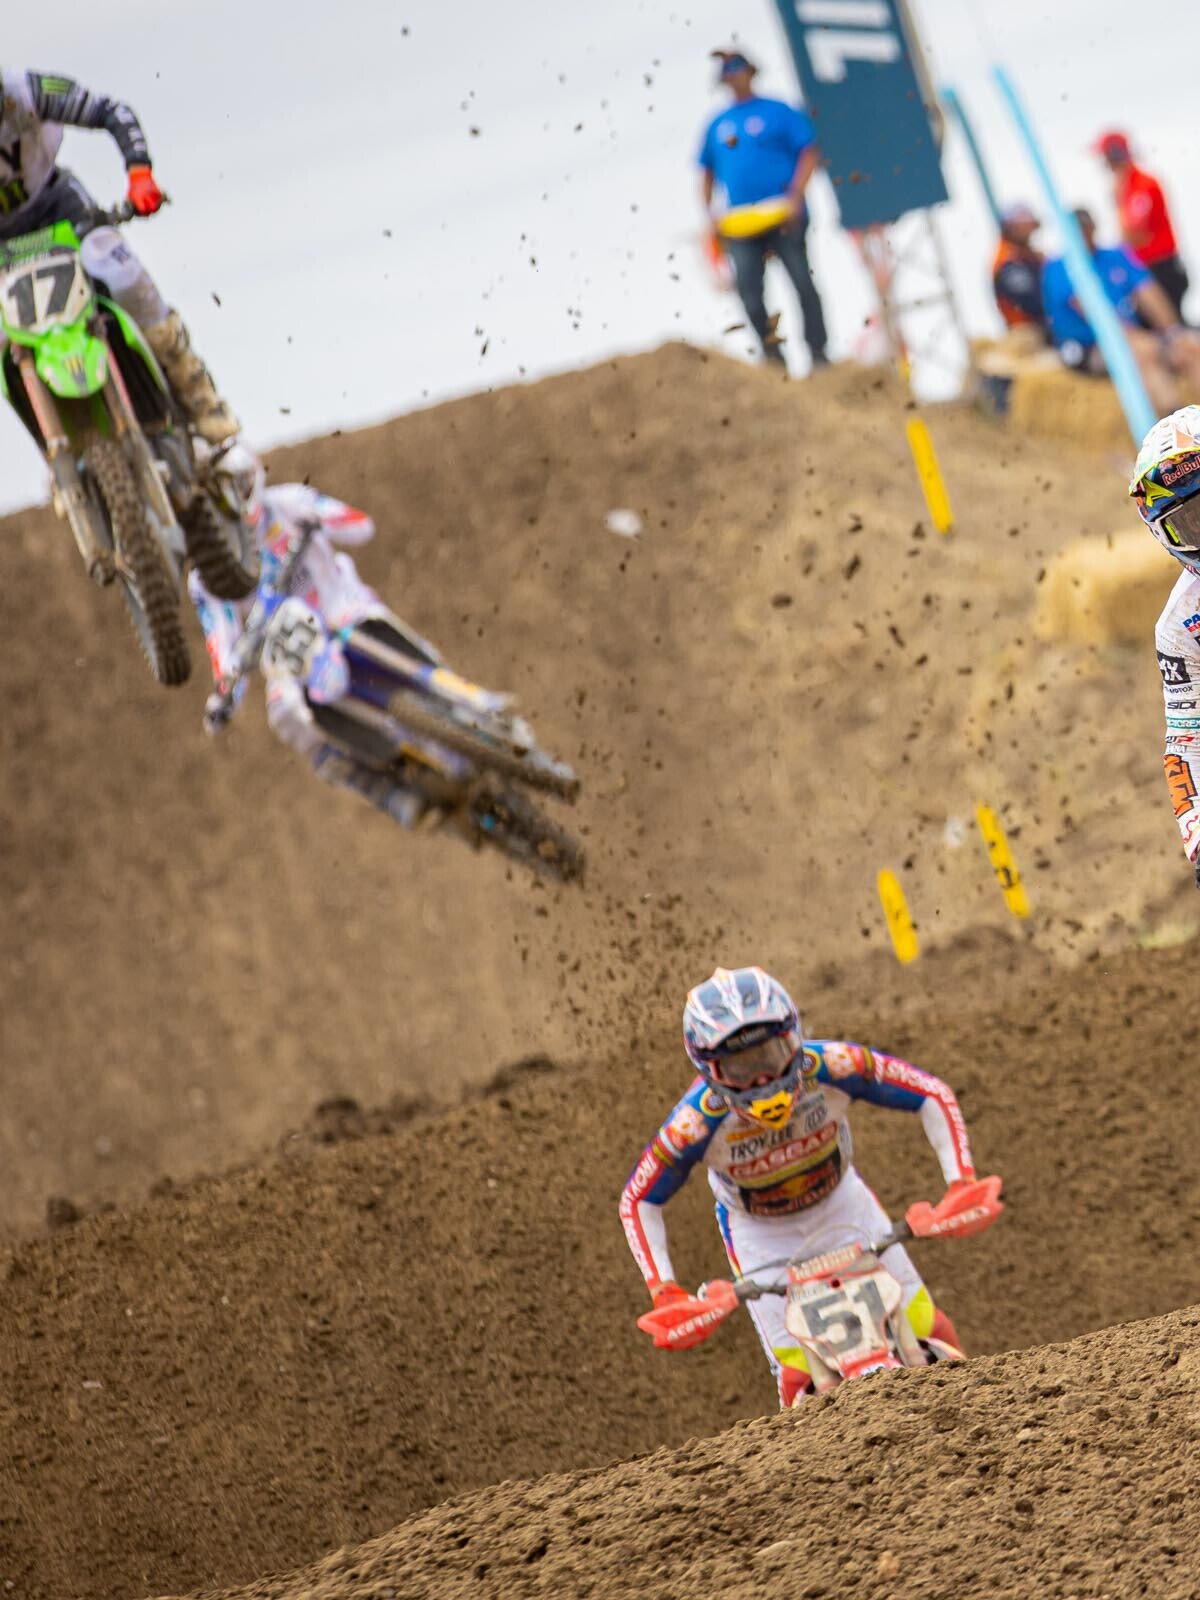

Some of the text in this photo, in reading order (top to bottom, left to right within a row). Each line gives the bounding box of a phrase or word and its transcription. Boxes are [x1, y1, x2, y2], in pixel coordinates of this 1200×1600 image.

[8, 262, 76, 327] 17
[1162, 467, 1183, 486] Red
[1164, 754, 1198, 819] KTM
[730, 1137, 766, 1161] TROY
[667, 1306, 725, 1341] ACERBIS
[800, 1279, 890, 1358] 51
